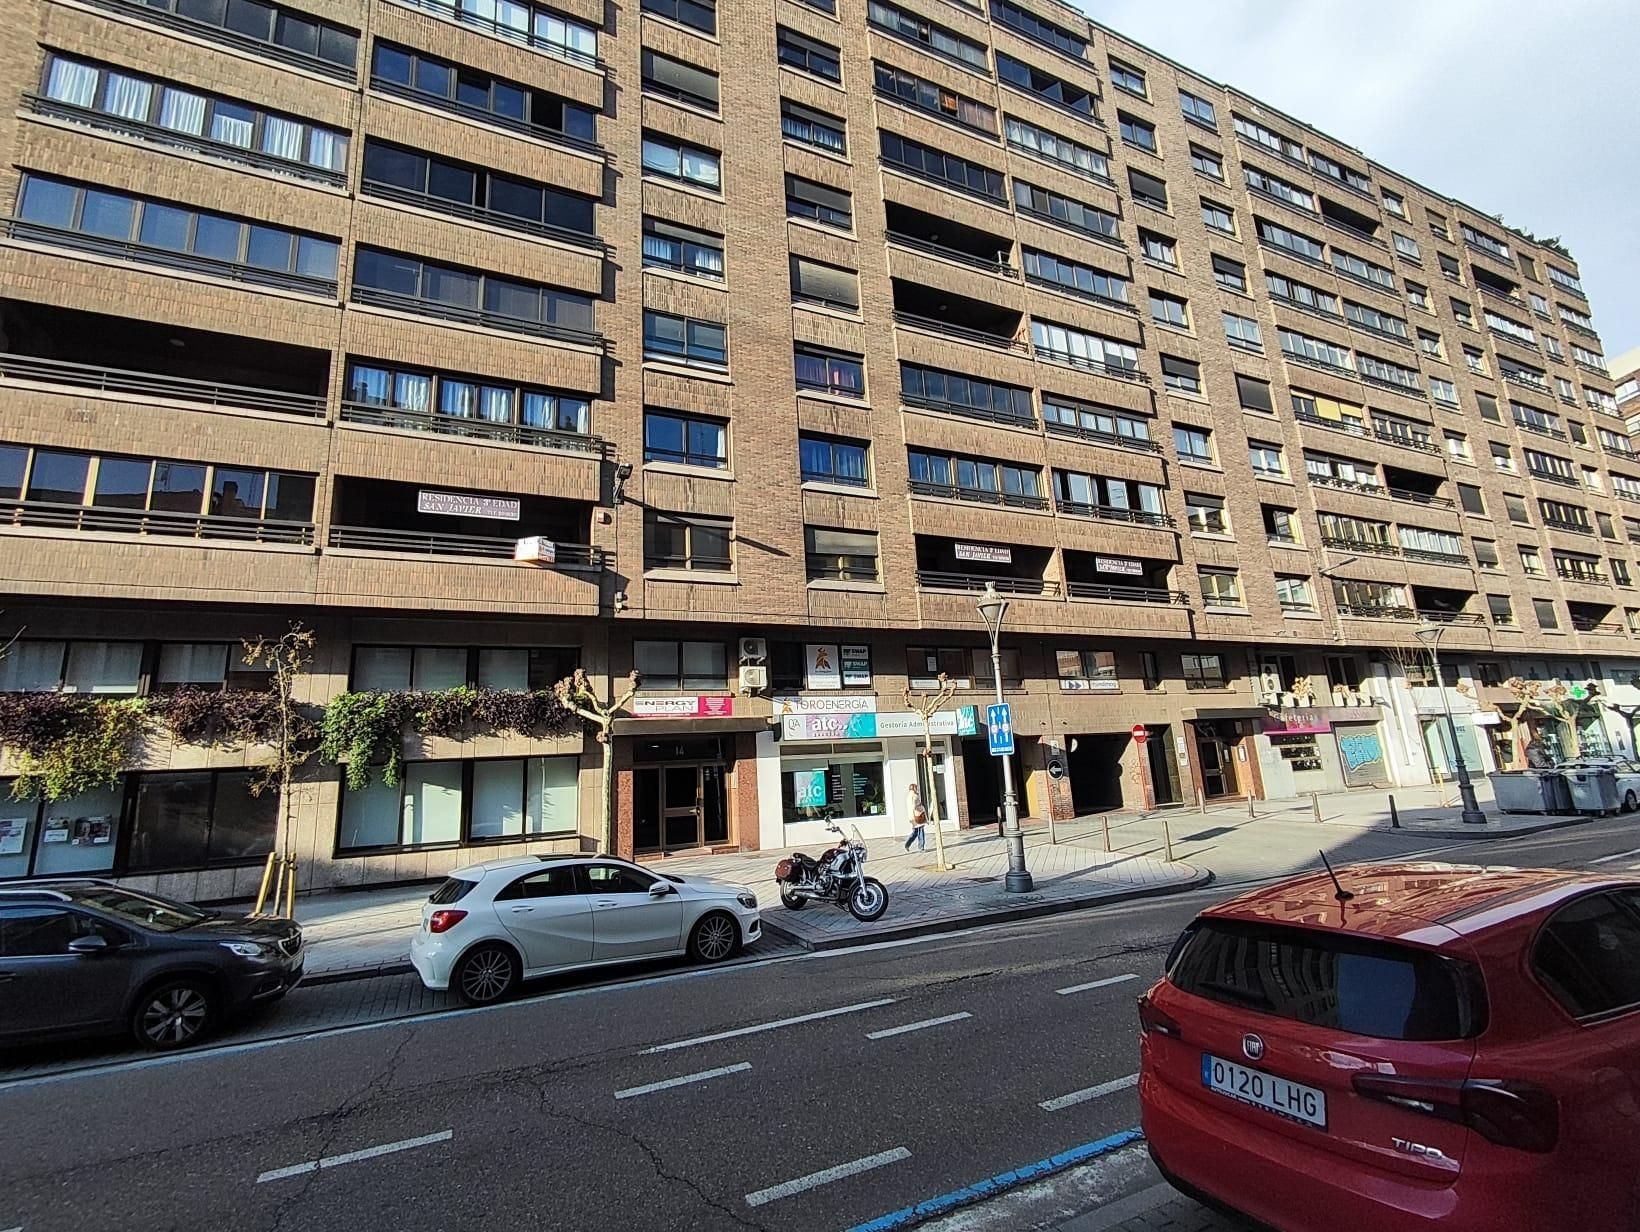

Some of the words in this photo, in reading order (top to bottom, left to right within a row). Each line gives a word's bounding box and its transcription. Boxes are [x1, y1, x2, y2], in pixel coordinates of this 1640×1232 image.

[422, 493, 479, 505] RESIDENCIA
[493, 500, 517, 509] EDAD
[424, 502, 444, 511] SAN
[447, 503, 481, 514] JAVIER
[1246, 1040, 1259, 1054] FIAT
[1214, 1062, 1264, 1099] 0120
[1272, 1080, 1317, 1117] LHG
[1391, 1136, 1442, 1158] TIPO
